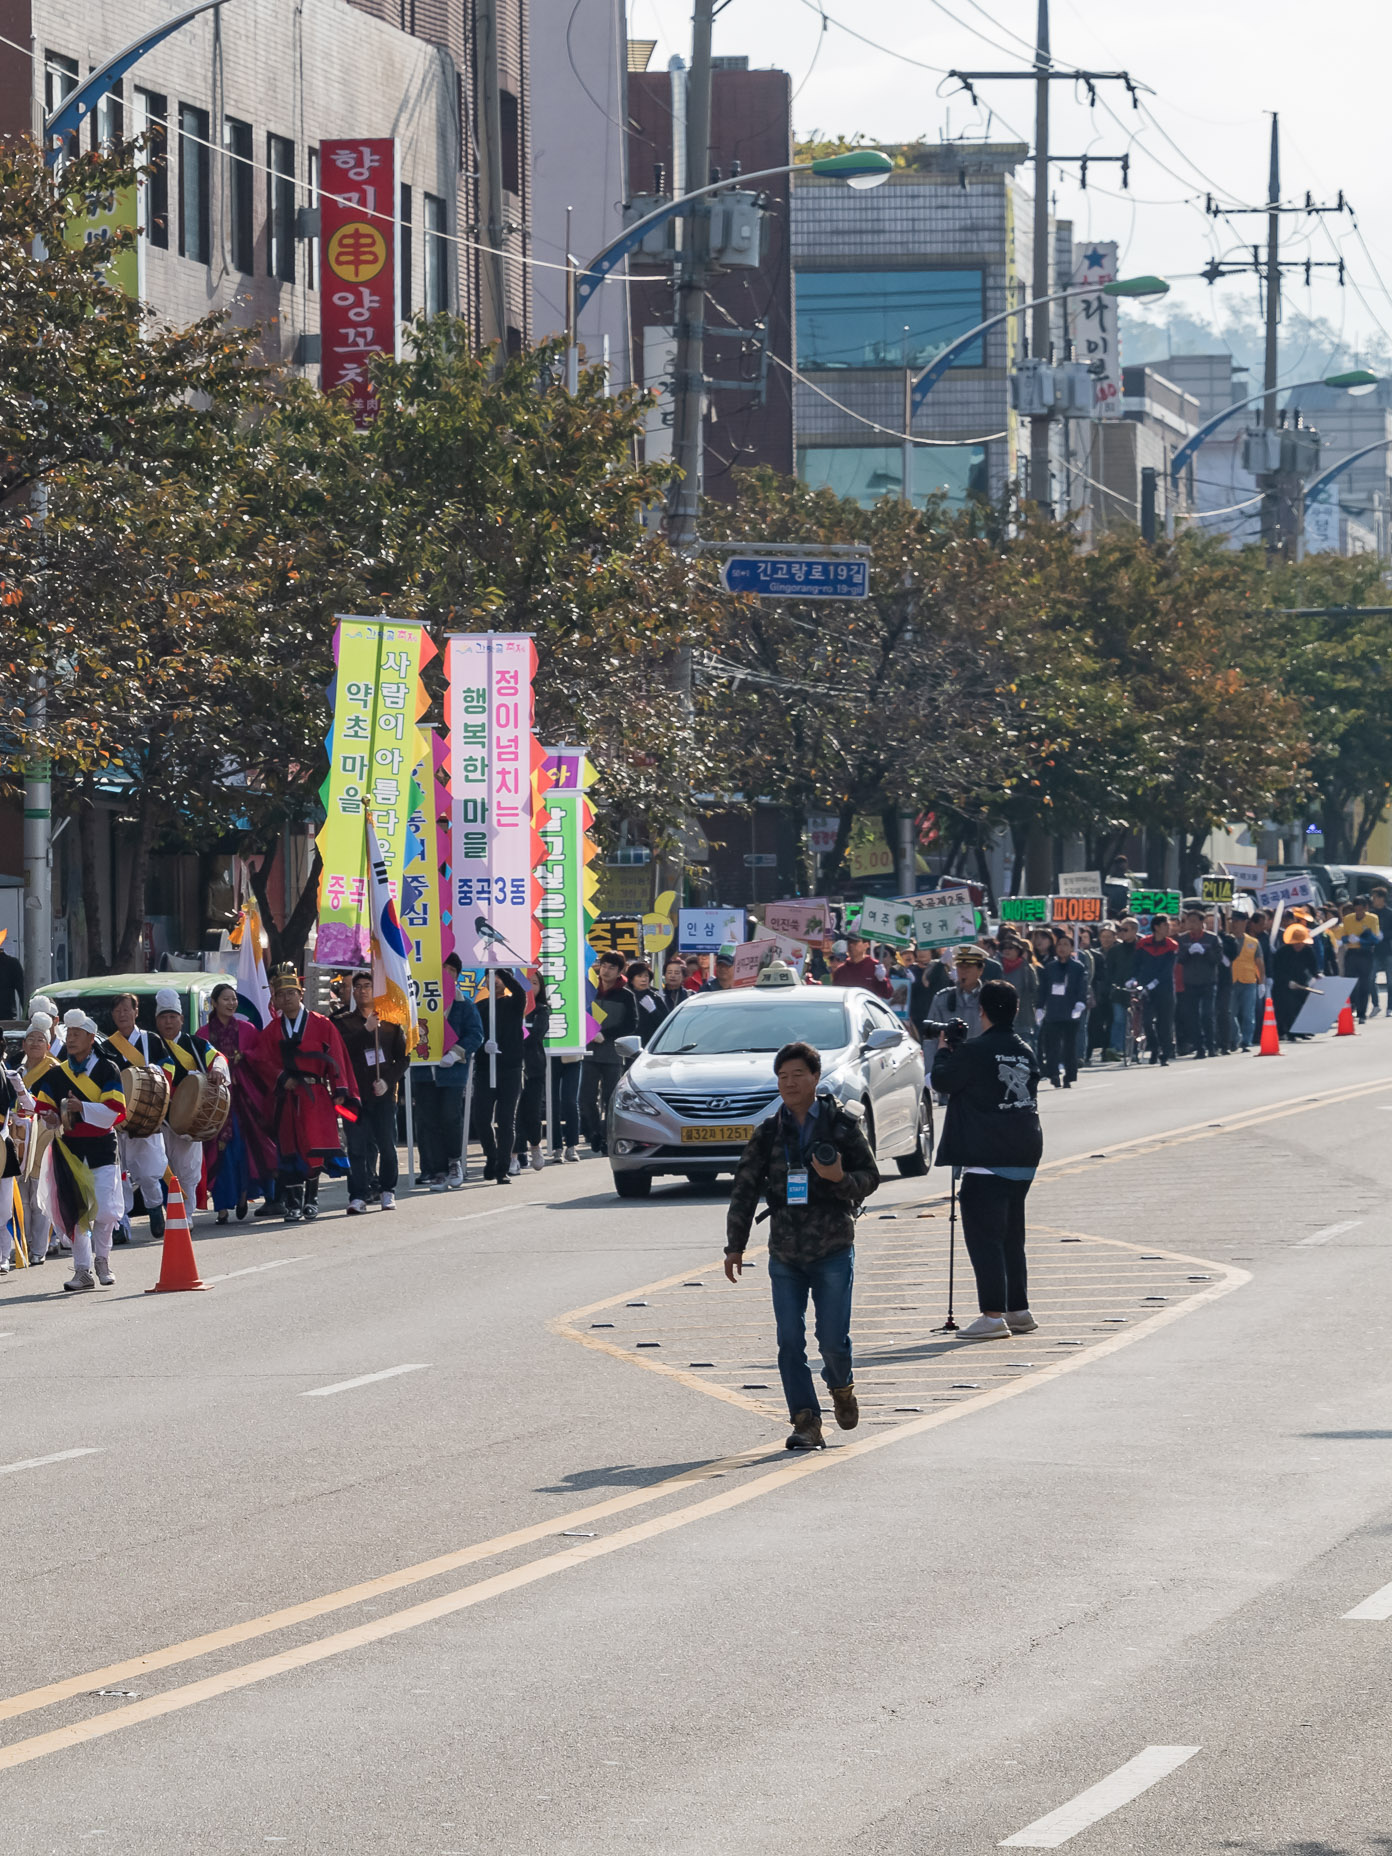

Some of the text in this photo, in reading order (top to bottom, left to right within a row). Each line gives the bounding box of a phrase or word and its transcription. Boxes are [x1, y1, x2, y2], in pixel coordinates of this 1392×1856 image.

[757, 563, 864, 584] 긴고랑로19길
[769, 582, 863, 595] Gingorang-ro 19-gil
[457, 876, 526, 907] 중곡3동
[1130, 890, 1180, 915] 중곡2동
[1052, 898, 1101, 921] 파이팅!
[720, 1127, 748, 1139] 1251
